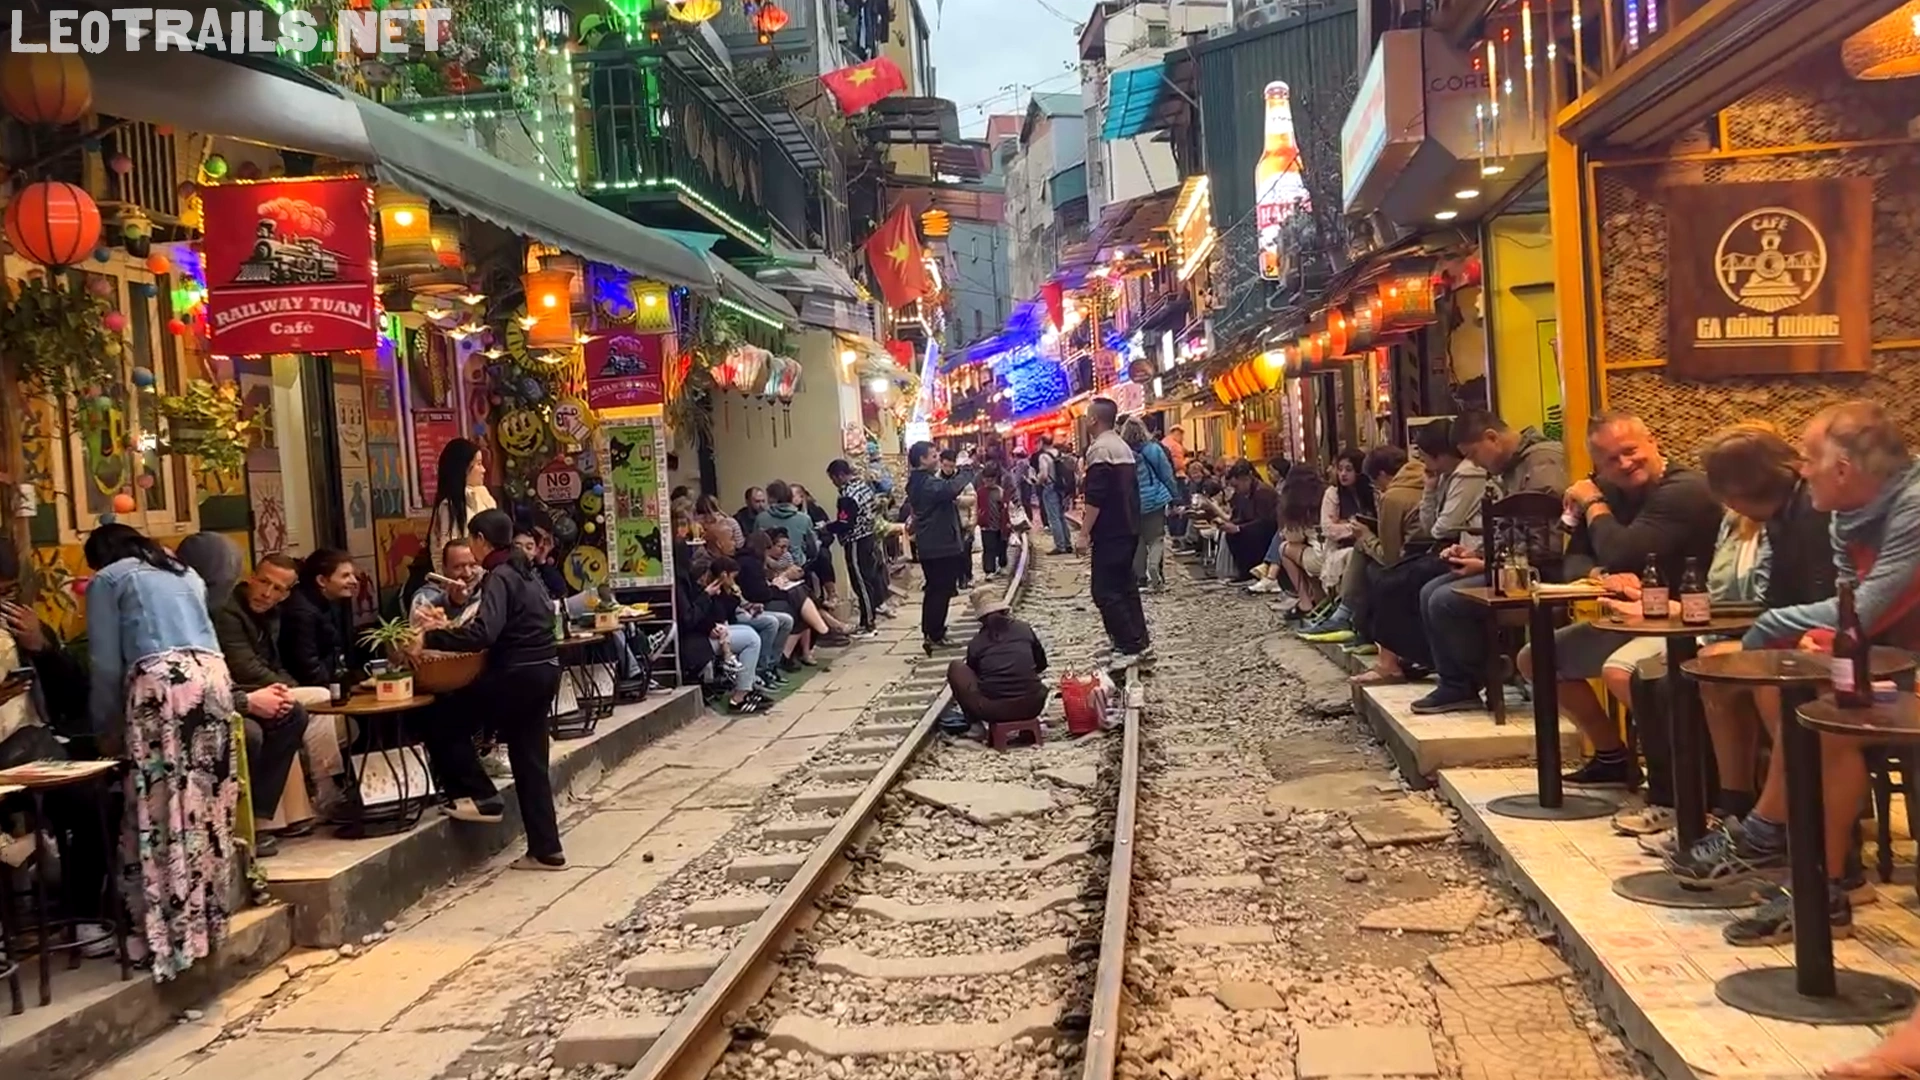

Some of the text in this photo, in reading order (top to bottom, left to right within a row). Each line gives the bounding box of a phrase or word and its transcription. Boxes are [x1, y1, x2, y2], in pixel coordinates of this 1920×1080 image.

[215, 297, 363, 326] RAILWAY TUAN
[270, 321, 314, 335] Café
[1697, 317, 1721, 338] GA
[546, 472, 571, 487] NO
